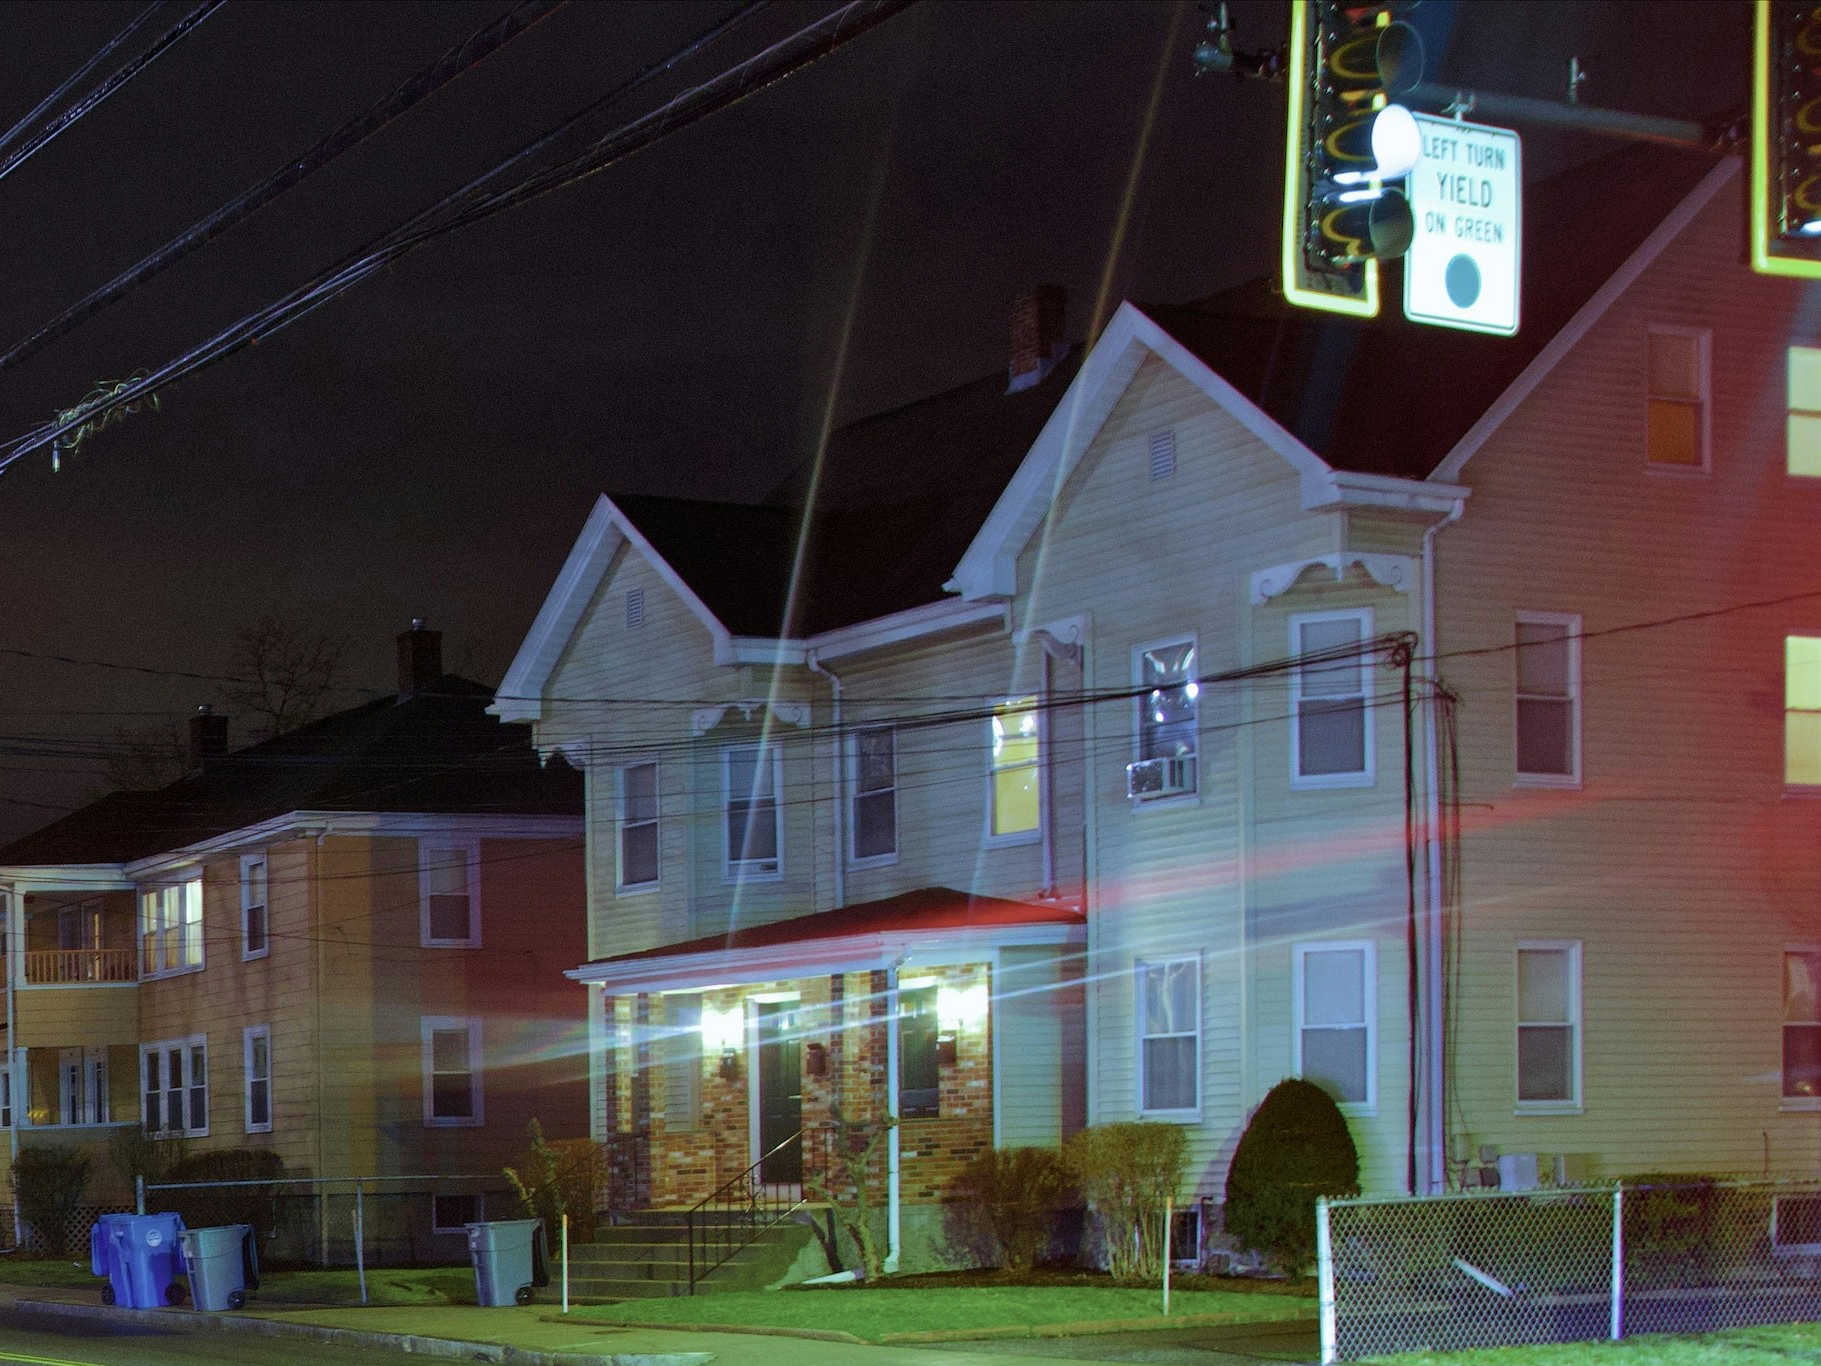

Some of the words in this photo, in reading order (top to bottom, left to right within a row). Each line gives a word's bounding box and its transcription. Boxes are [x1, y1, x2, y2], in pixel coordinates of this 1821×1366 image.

[1423, 135, 1458, 162] LEFT
[1466, 143, 1506, 170] TURN
[1436, 171, 1492, 208] YIELD
[1425, 211, 1446, 234] ON
[1455, 216, 1505, 243] GREEN
